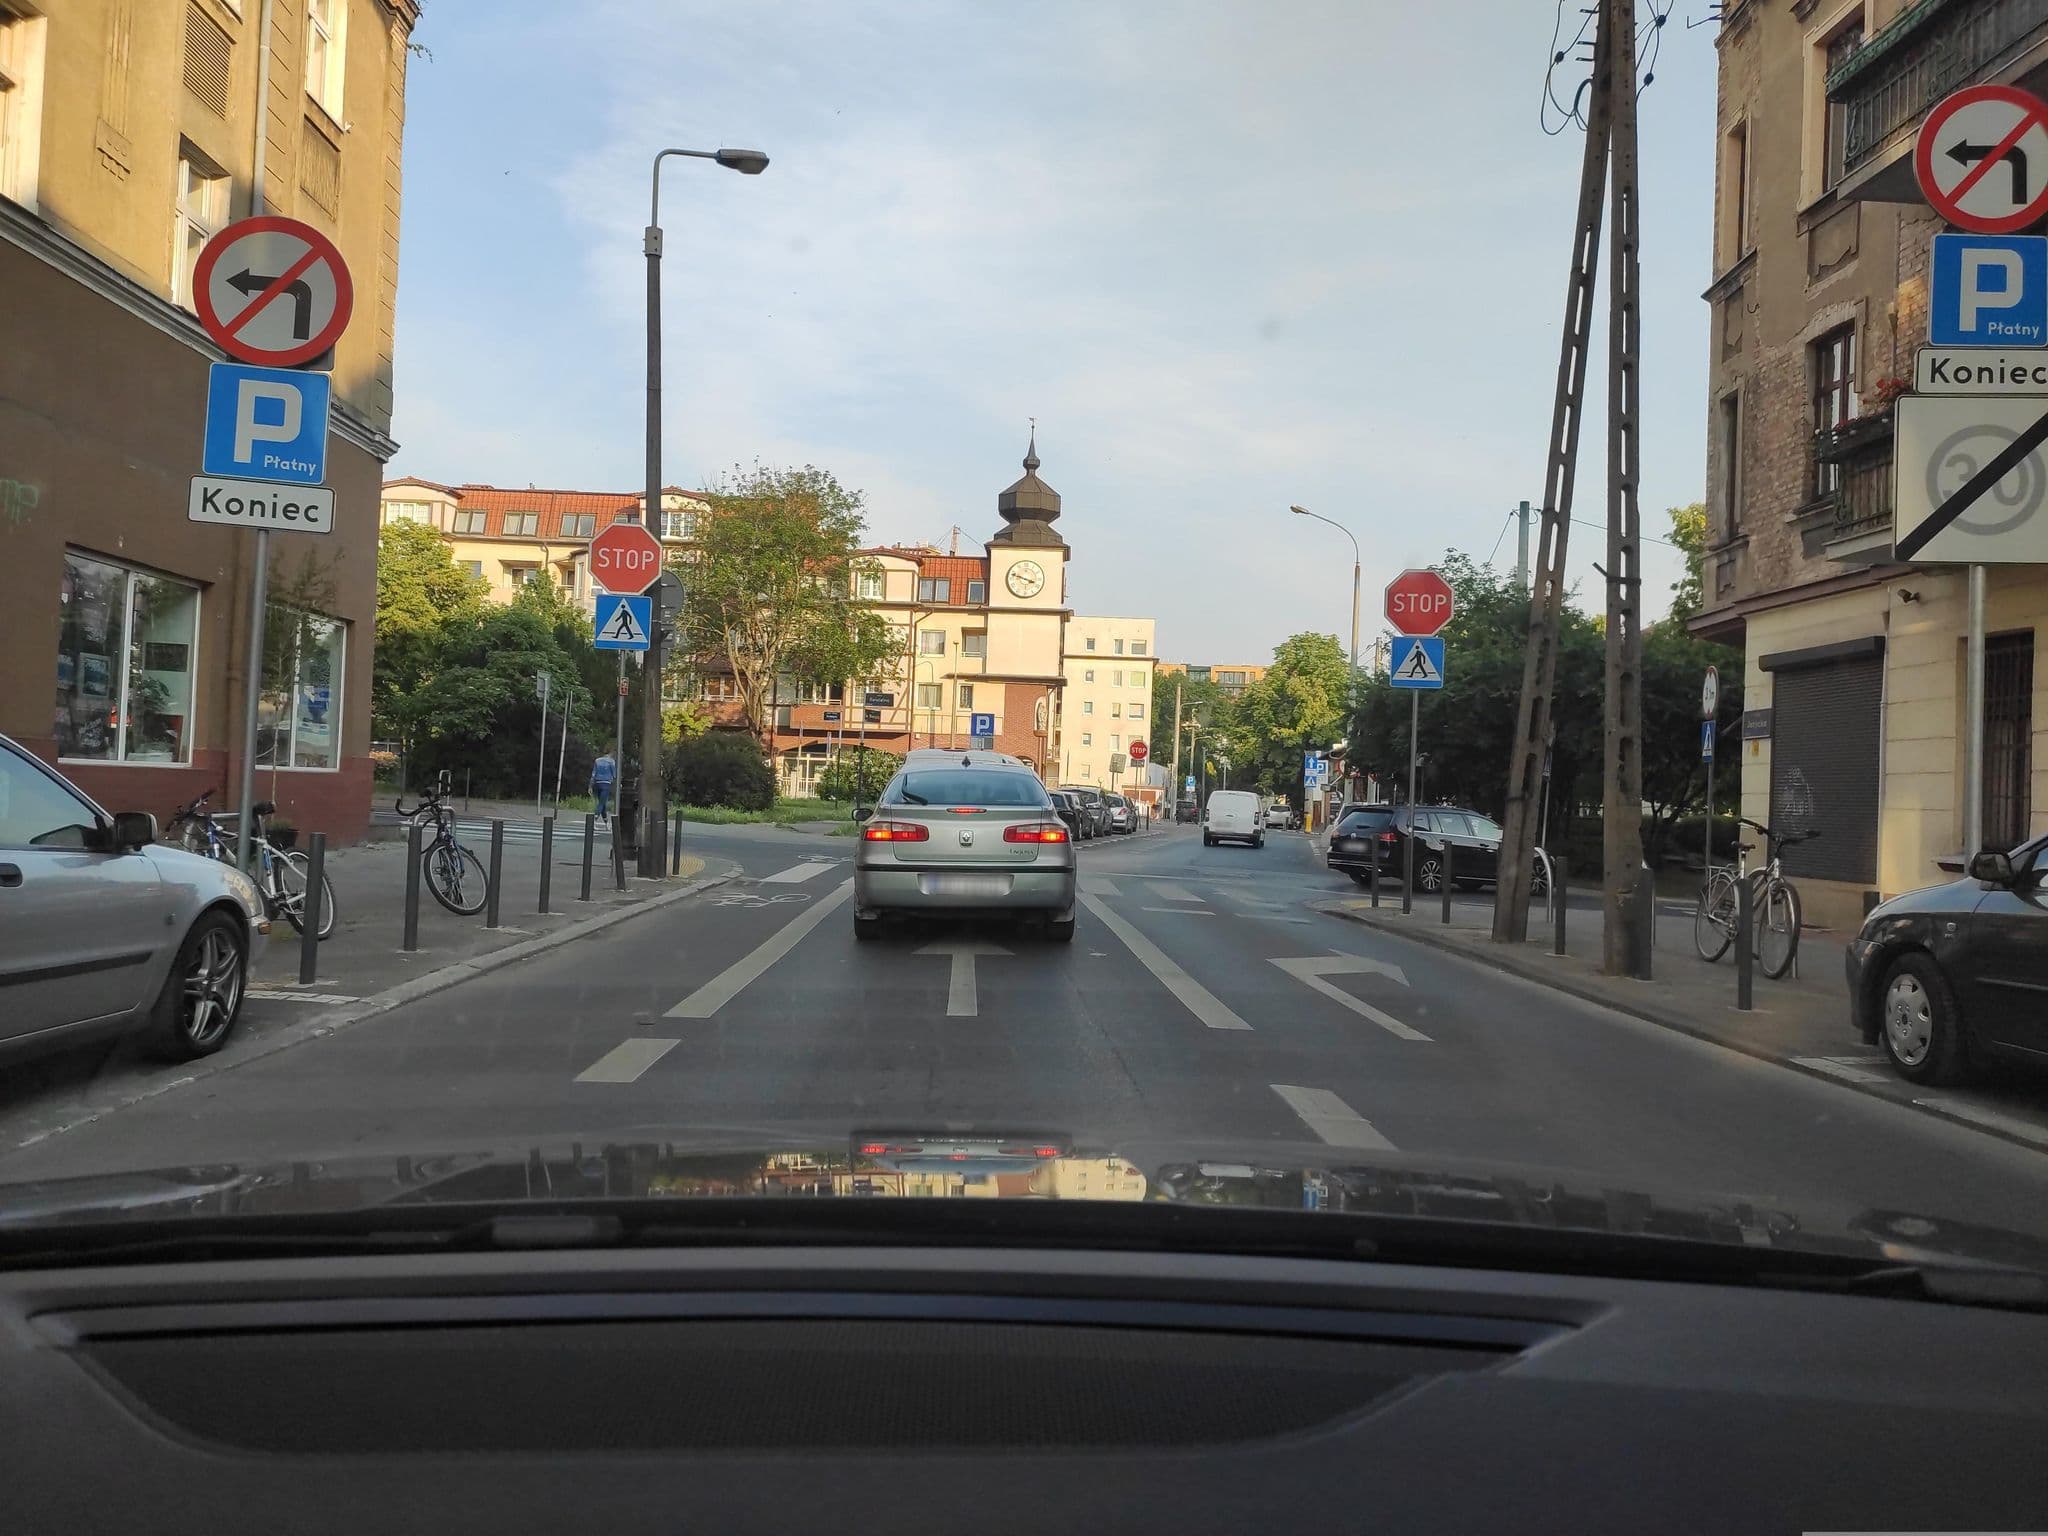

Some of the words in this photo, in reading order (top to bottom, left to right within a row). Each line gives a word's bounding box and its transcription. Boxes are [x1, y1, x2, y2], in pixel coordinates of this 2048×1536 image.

[1959, 248, 2024, 332] P
[1988, 321, 2040, 339] Płatny
[1930, 357, 2048, 385] Koniec
[233, 378, 303, 464] P
[263, 454, 317, 477] Płatny
[201, 486, 320, 523] Koniec
[598, 547, 655, 571] STOP
[1393, 593, 1447, 613] STOP
[976, 715, 990, 735] P
